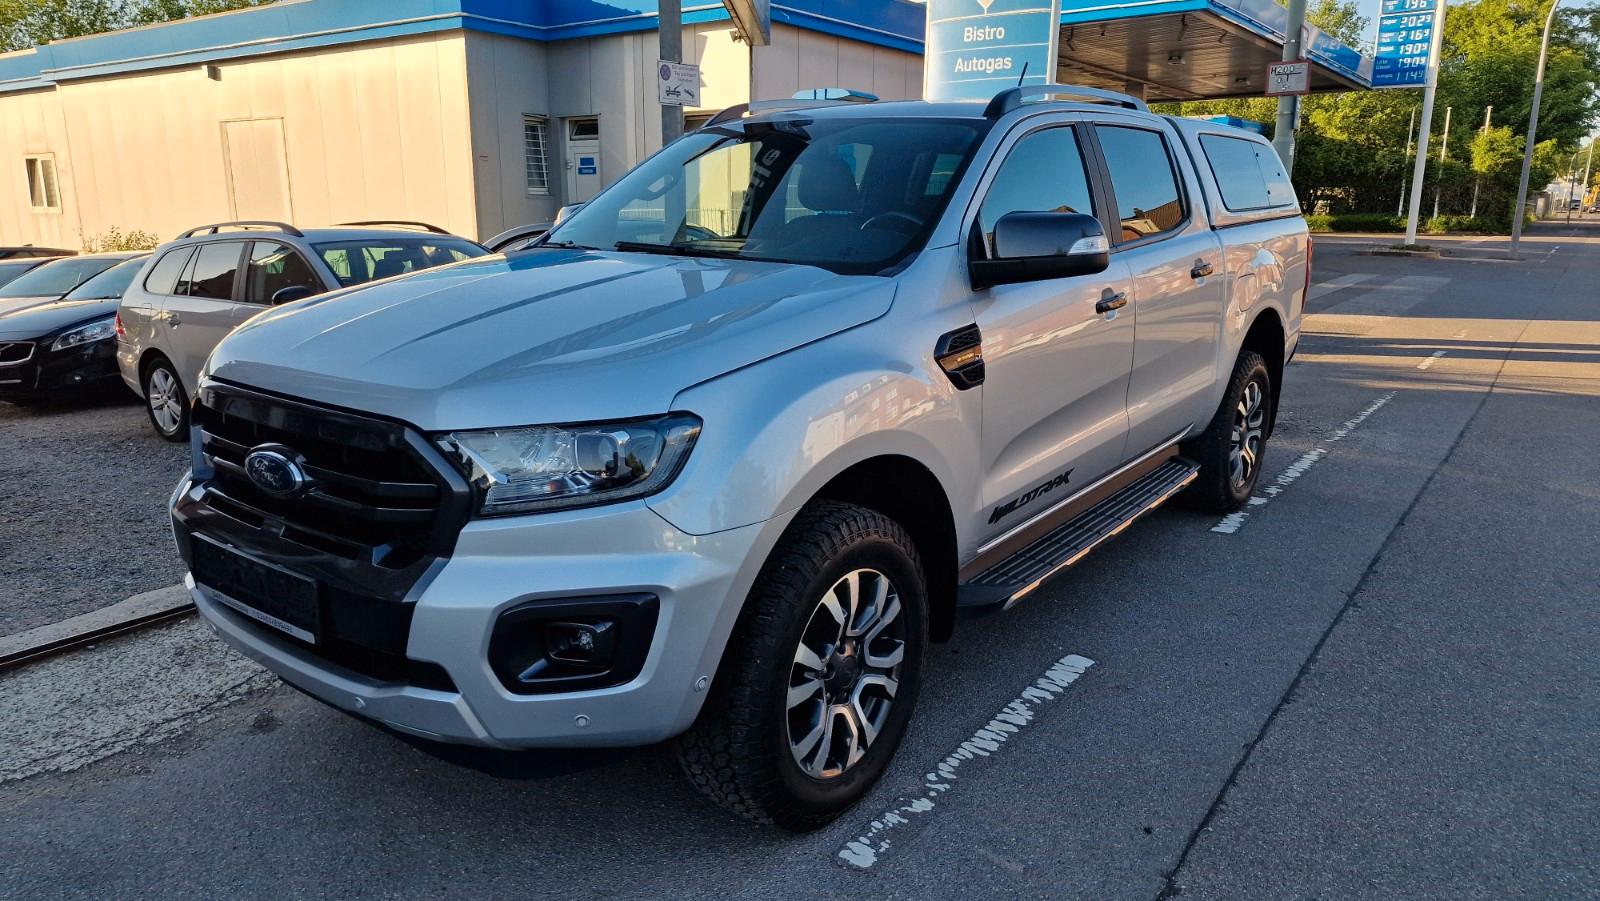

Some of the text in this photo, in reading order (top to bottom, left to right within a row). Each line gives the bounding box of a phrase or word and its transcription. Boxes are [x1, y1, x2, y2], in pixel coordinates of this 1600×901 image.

[963, 26, 1005, 42] Bistro
[954, 57, 1012, 74] Autogas
[253, 457, 284, 487] Ford
[988, 467, 1075, 524] WILDTRAK
